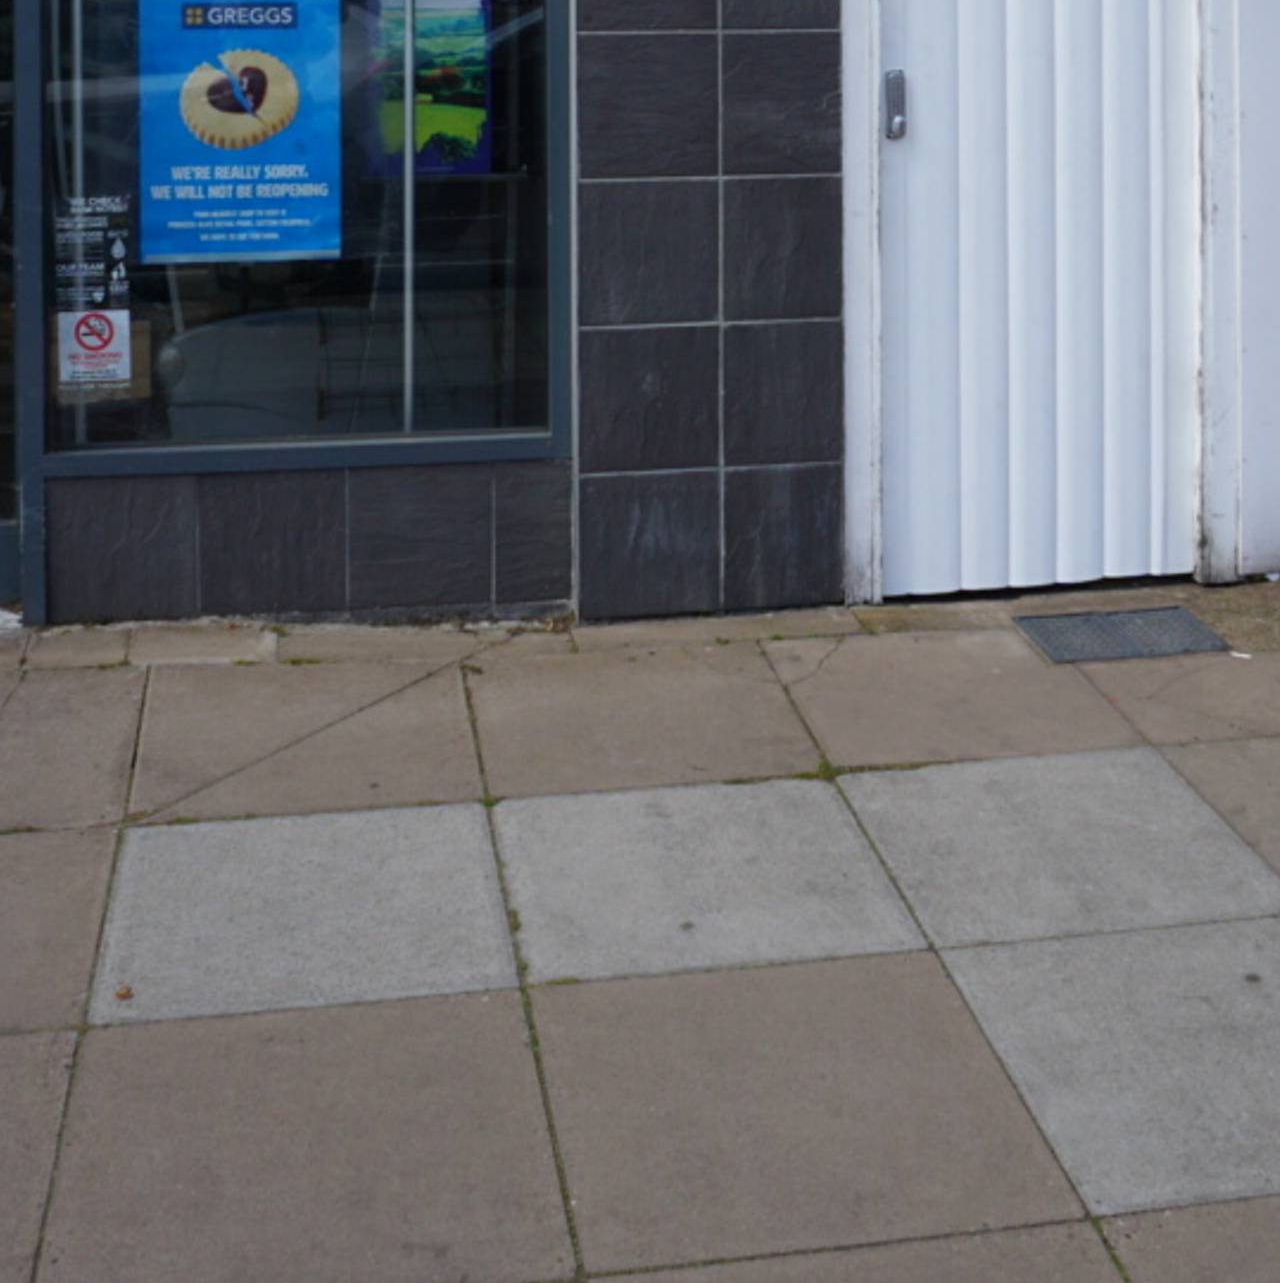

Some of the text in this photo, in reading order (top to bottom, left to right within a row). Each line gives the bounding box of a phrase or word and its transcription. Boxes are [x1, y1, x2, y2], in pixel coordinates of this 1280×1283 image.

[207, 7, 293, 25] GREGGS
[214, 165, 261, 179] REALLY
[150, 183, 329, 199] WE WILL NOT BE REOPENING
